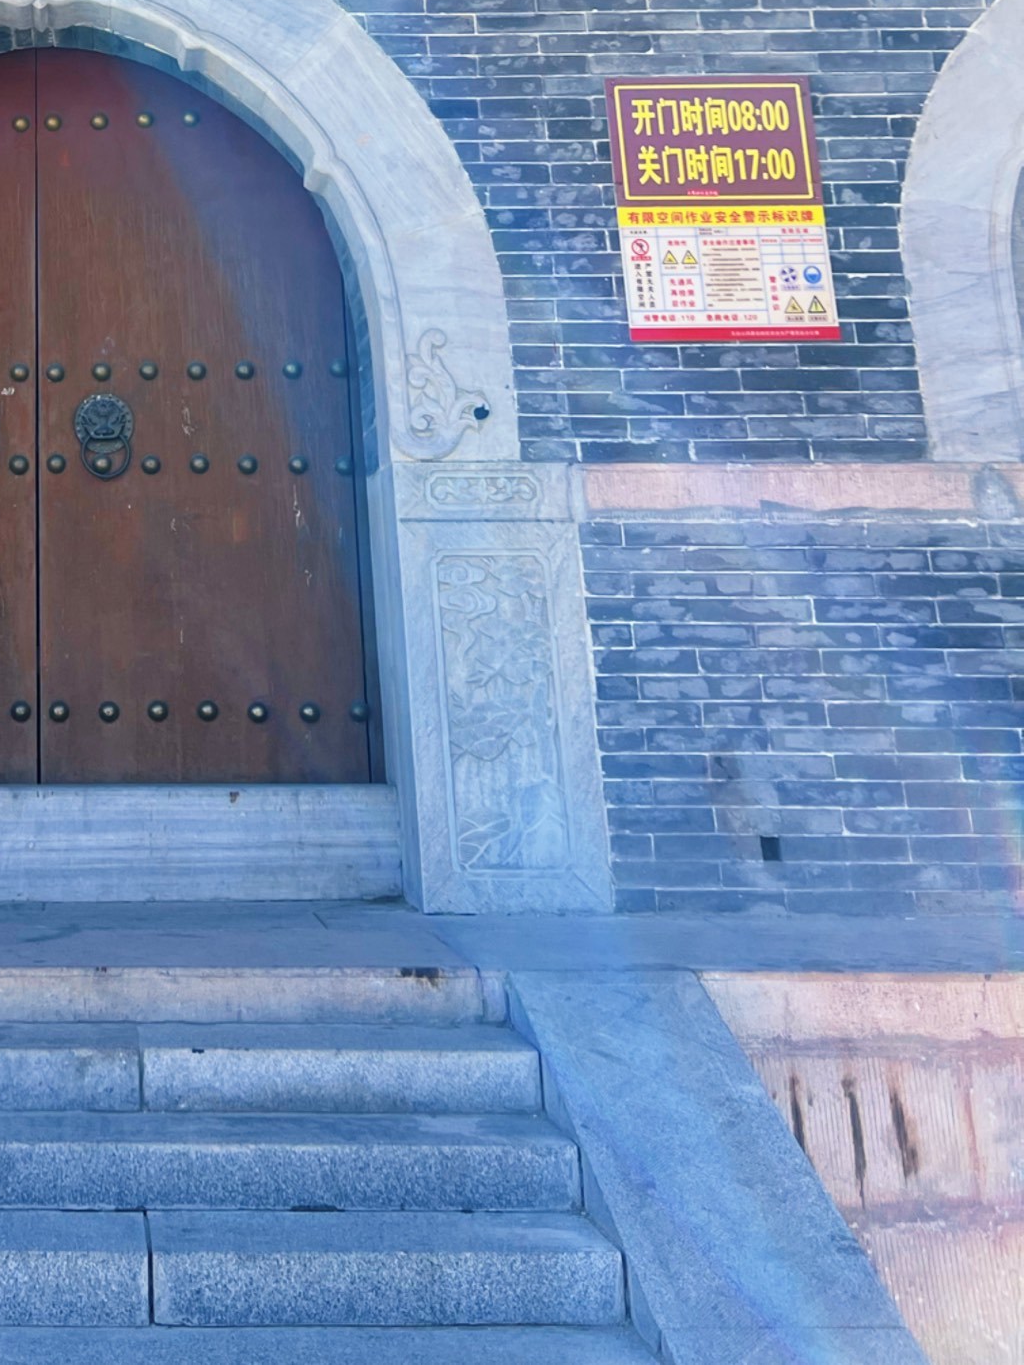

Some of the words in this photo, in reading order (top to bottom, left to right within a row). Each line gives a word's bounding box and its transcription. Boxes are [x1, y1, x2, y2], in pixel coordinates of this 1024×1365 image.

[631, 97, 789, 136] 开门时间08:00
[637, 145, 796, 185] 关门时间17:00
[627, 210, 814, 224] 有限空间作业安全警示标识牌
